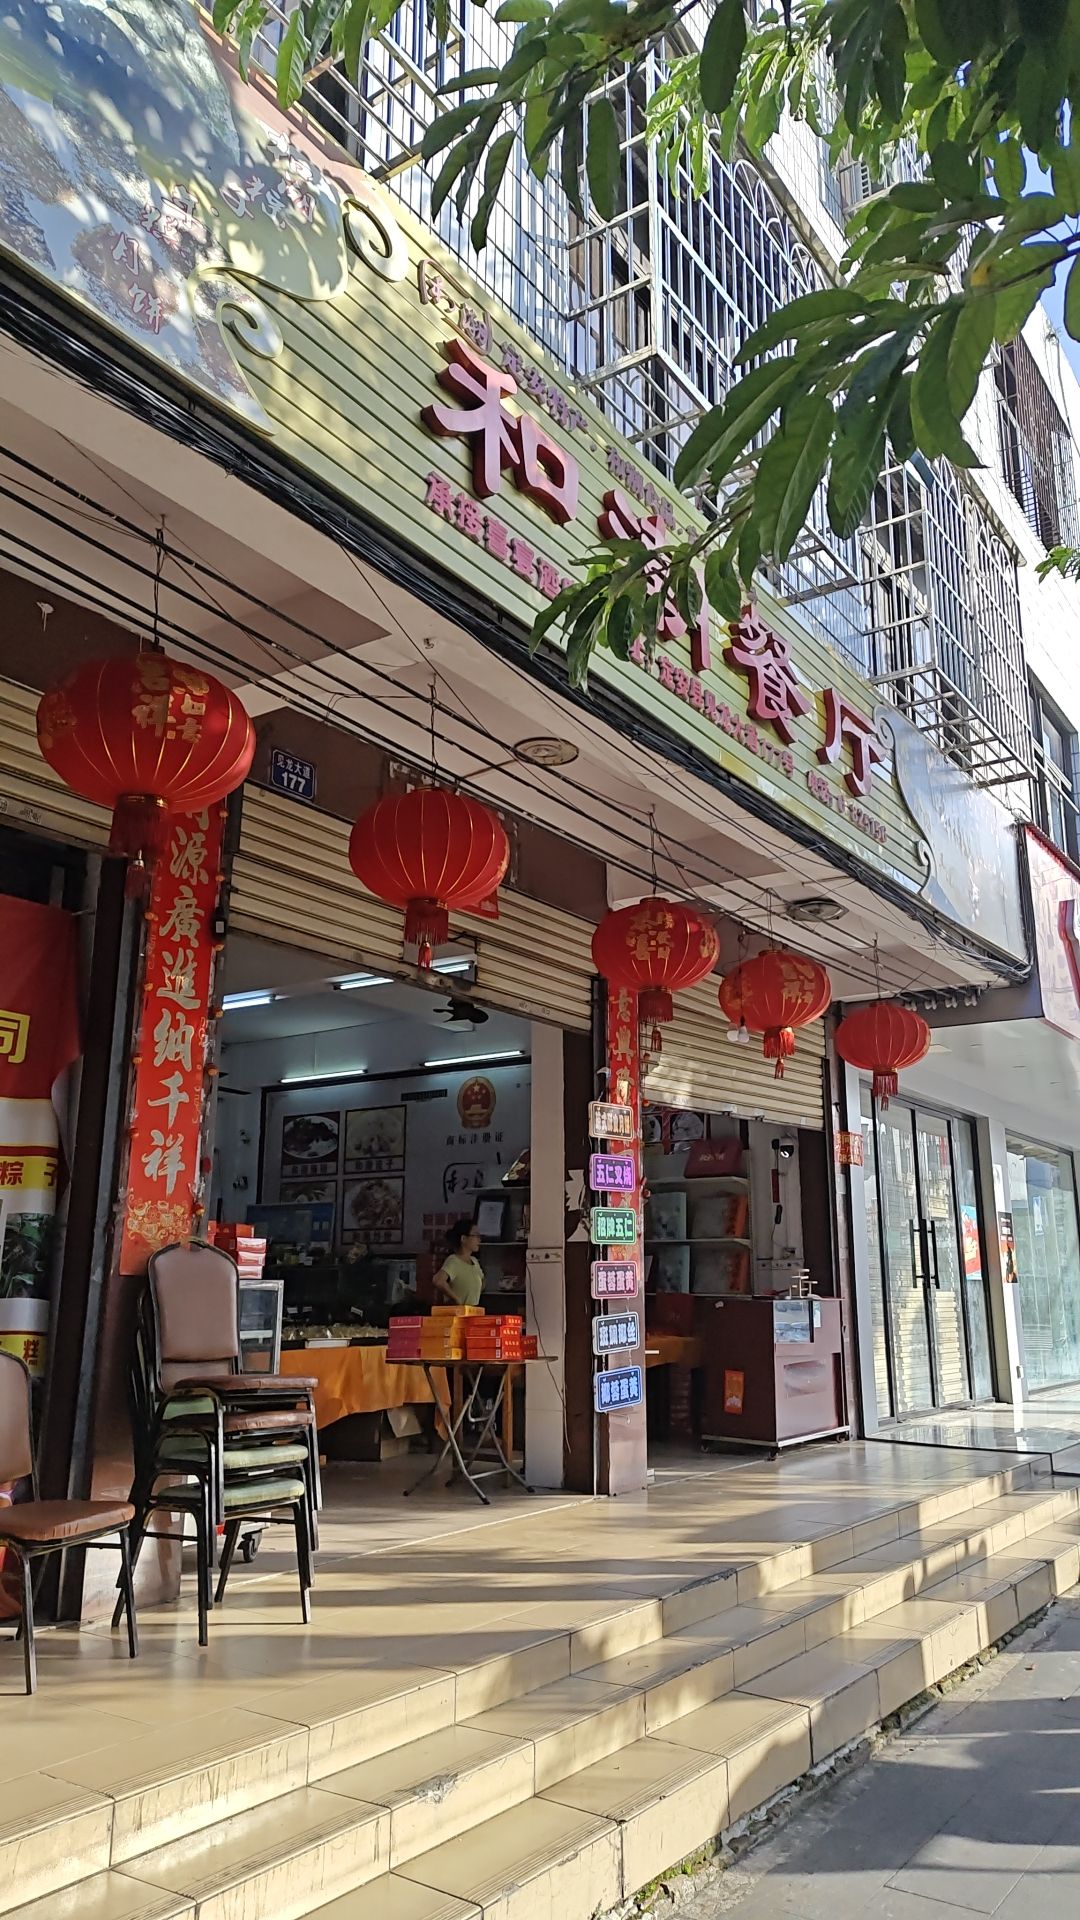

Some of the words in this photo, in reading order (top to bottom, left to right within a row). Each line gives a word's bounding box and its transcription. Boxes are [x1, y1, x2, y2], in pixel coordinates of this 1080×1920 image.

[426, 471, 575, 600] 承接喜宴酒
[276, 754, 311, 780] 见龙大道
[282, 771, 306, 793] 177
[596, 1163, 632, 1186] 五仁叉烧
[597, 1216, 633, 1238] 招牌五仁
